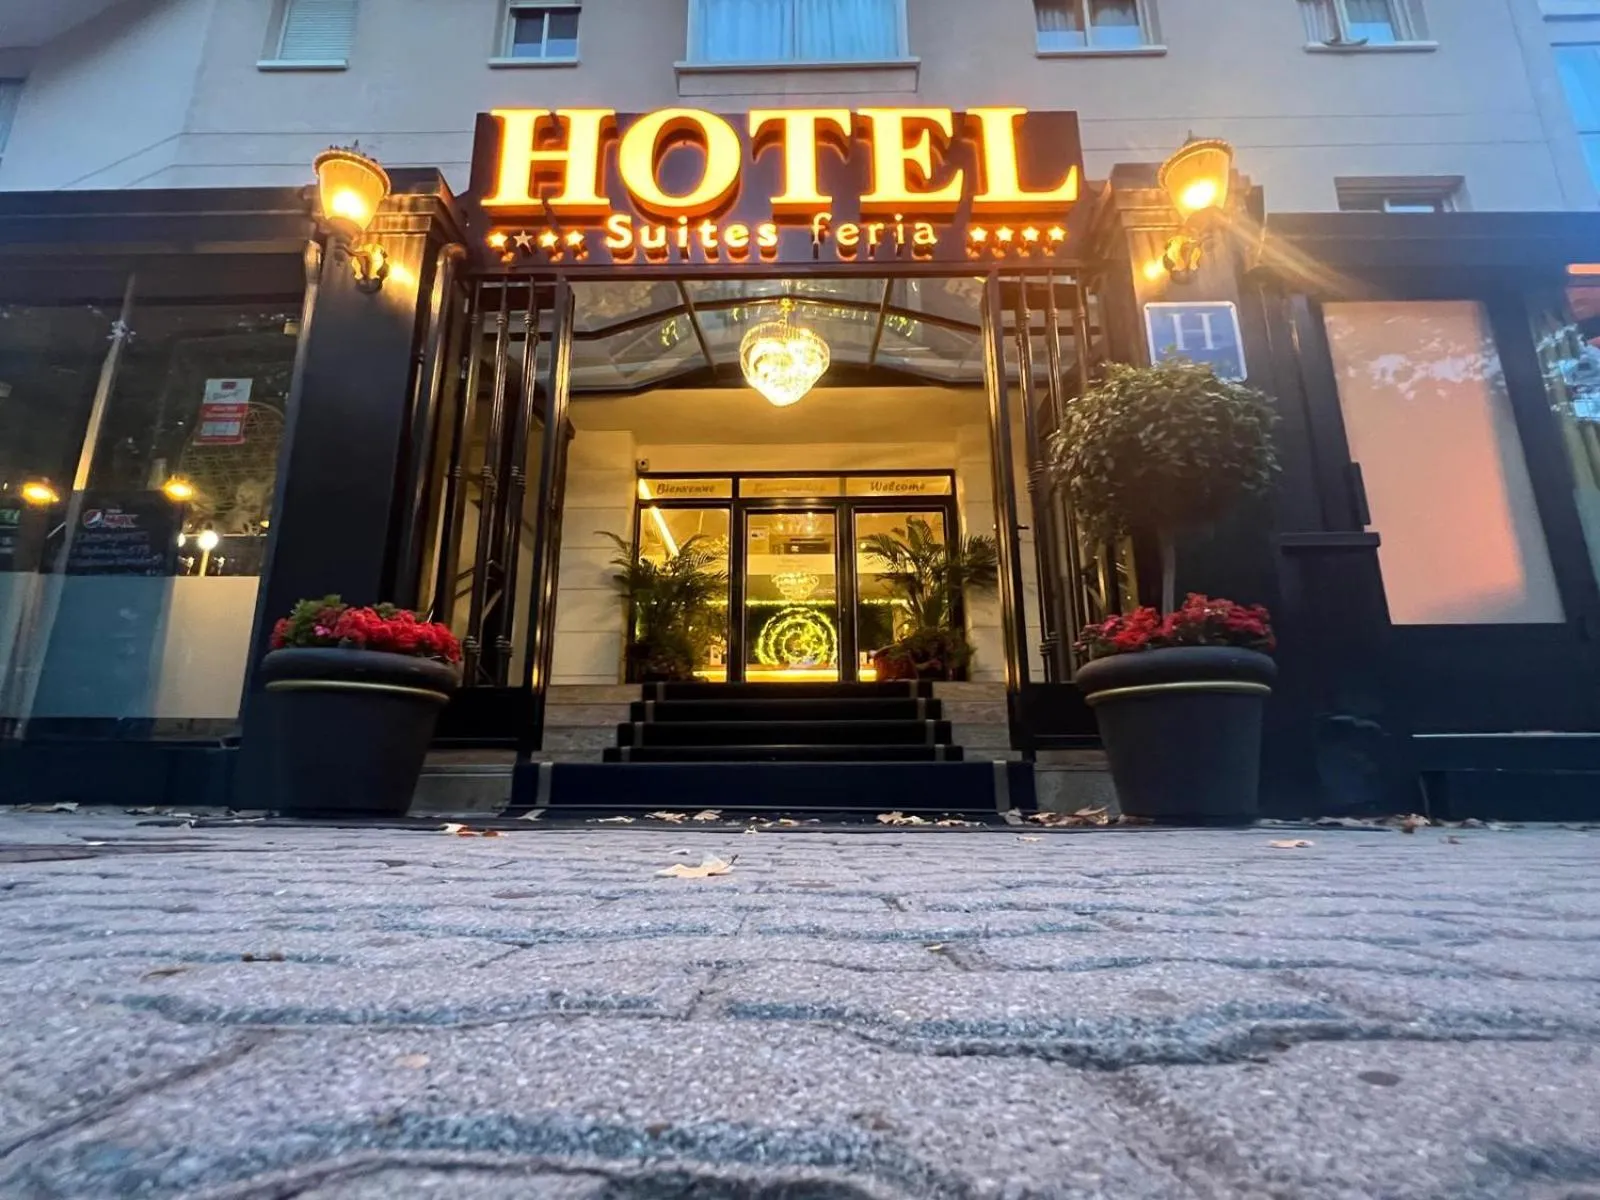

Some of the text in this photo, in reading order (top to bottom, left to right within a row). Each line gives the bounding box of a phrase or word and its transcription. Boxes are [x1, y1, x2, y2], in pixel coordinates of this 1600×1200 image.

[480, 107, 1078, 209] HOTEL
[604, 211, 937, 249] Suites feria
[1167, 312, 1219, 351] H
[869, 480, 926, 493] Welcome
